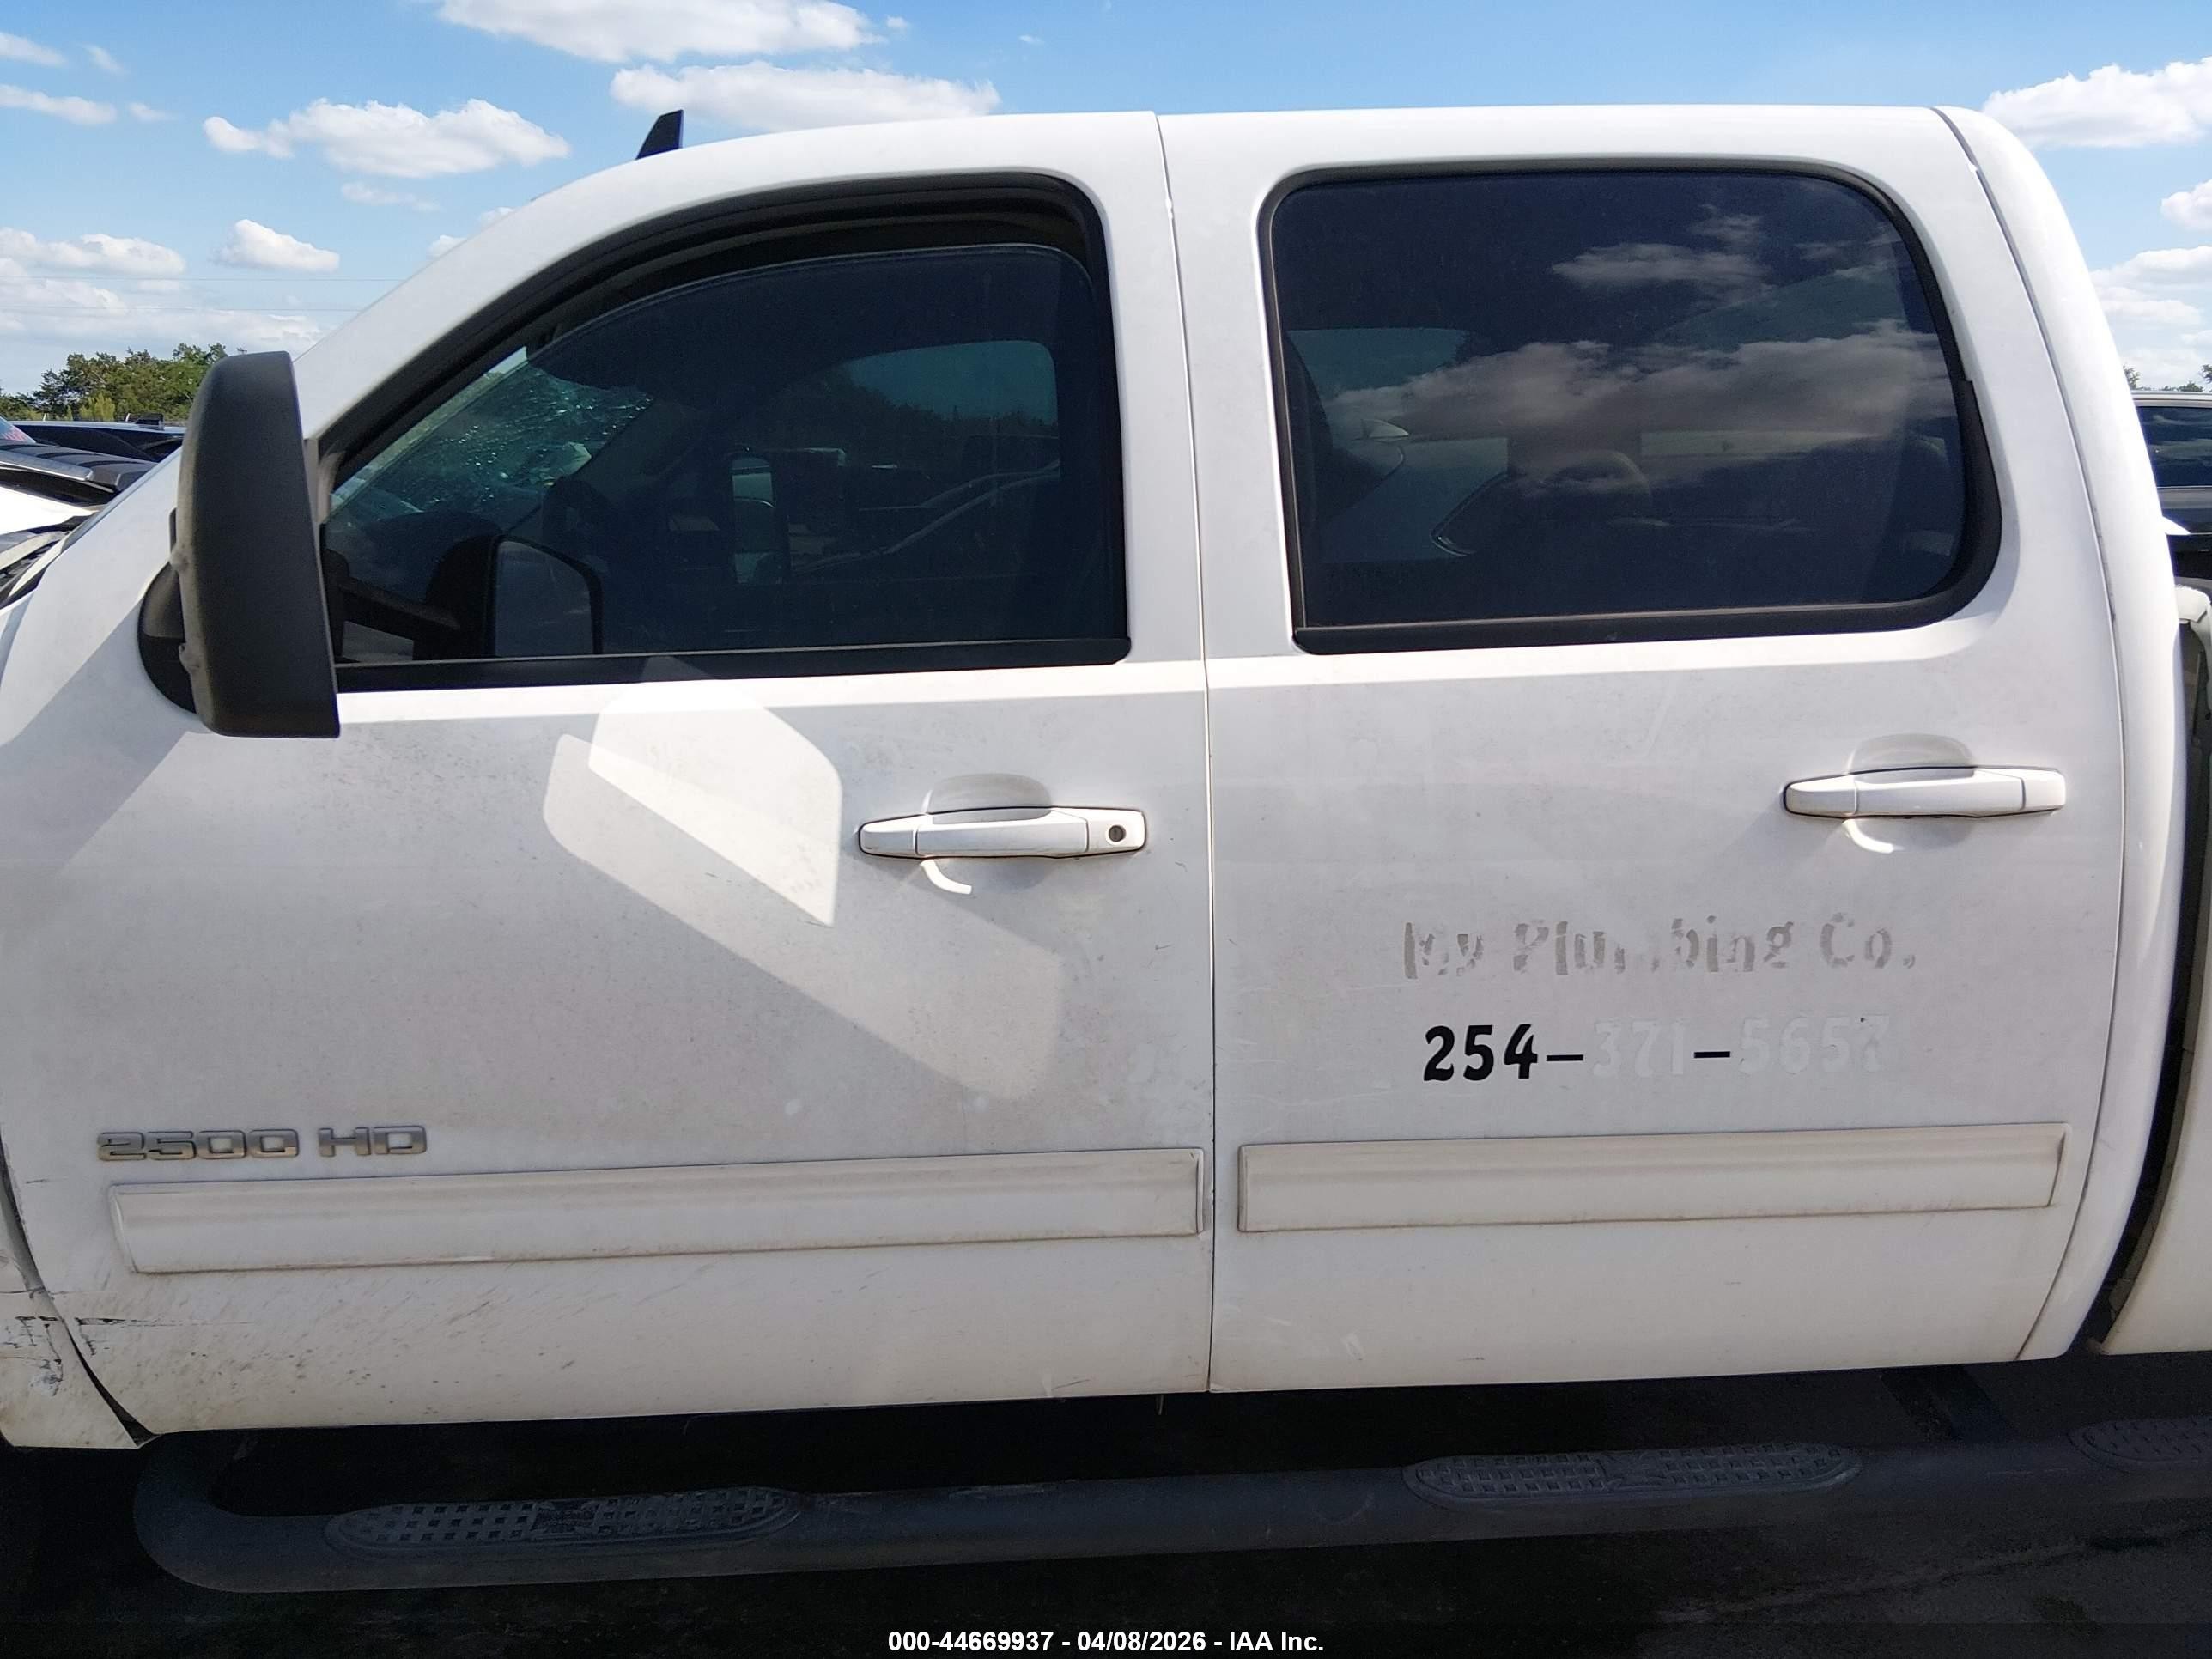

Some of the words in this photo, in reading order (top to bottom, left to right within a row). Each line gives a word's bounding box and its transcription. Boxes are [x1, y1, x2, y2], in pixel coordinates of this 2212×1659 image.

[1514, 915, 1795, 975] Plubing
[96, 1129, 300, 1161] 2500
[318, 1126, 428, 1158] HD
